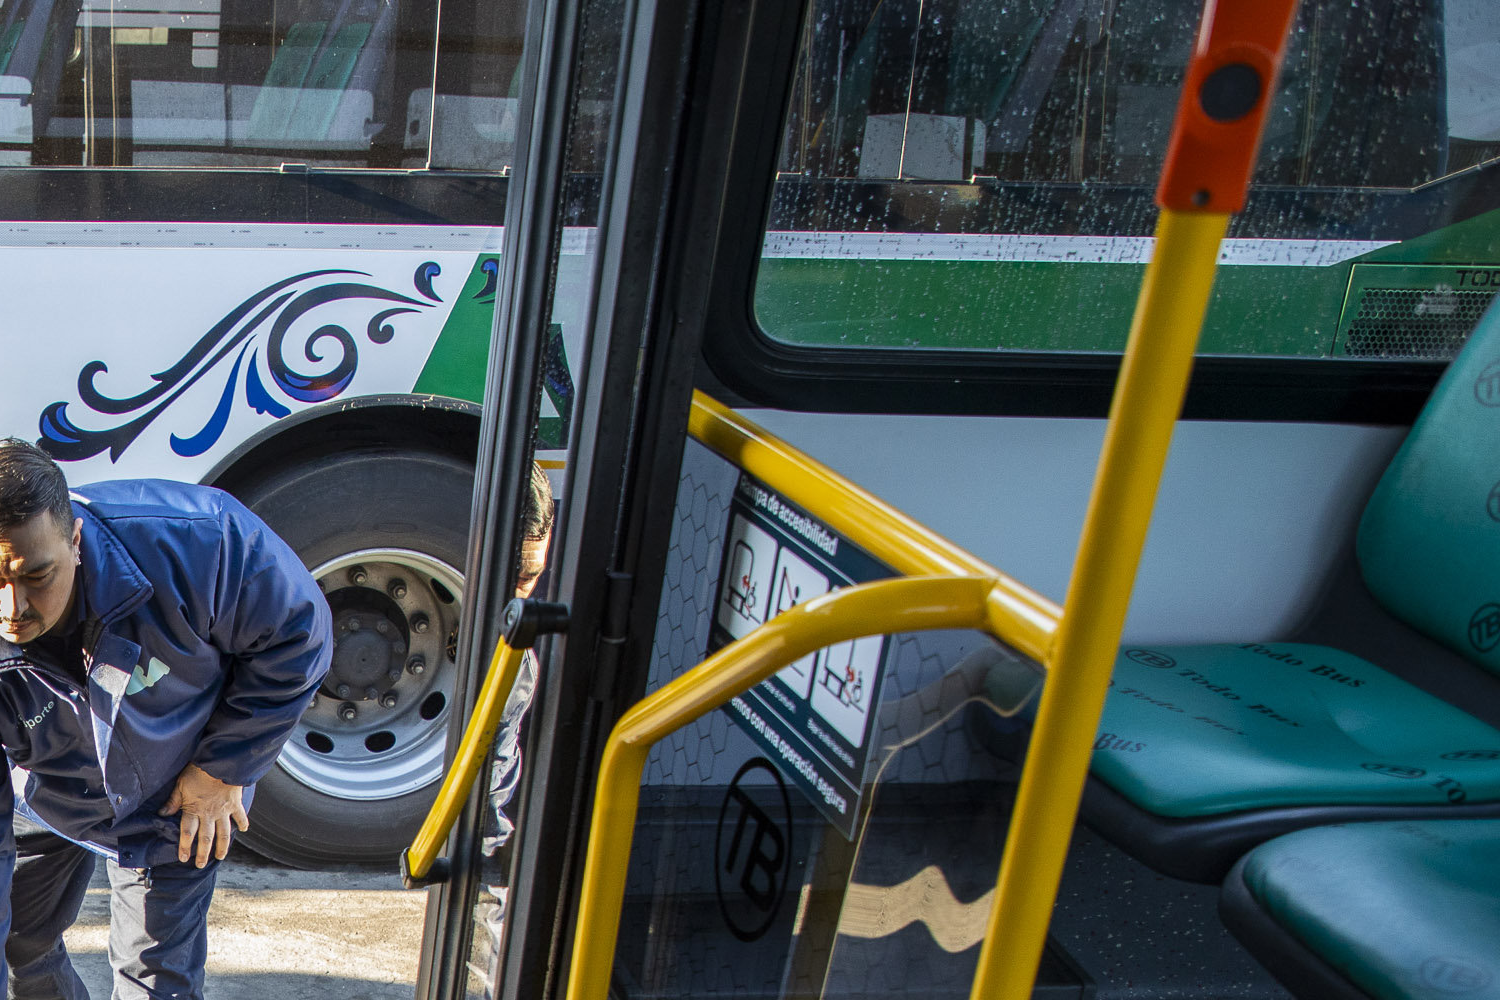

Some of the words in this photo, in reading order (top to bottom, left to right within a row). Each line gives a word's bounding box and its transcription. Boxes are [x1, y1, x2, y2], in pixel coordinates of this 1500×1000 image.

[740, 474, 769, 508] Rampa
[767, 494, 781, 516] de
[778, 504, 838, 556] accesibilidad
[1177, 669, 1241, 700] Todo
[1246, 703, 1304, 728] Bus
[1240, 643, 1304, 666] Todo
[1308, 664, 1367, 689] Bus
[730, 697, 753, 721] emos
[750, 712, 767, 735] con
[764, 726, 781, 749] una
[778, 739, 819, 786] operación
[816, 777, 848, 815] segura
[1094, 733, 1148, 753] Bus
[722, 774, 788, 922] TB
